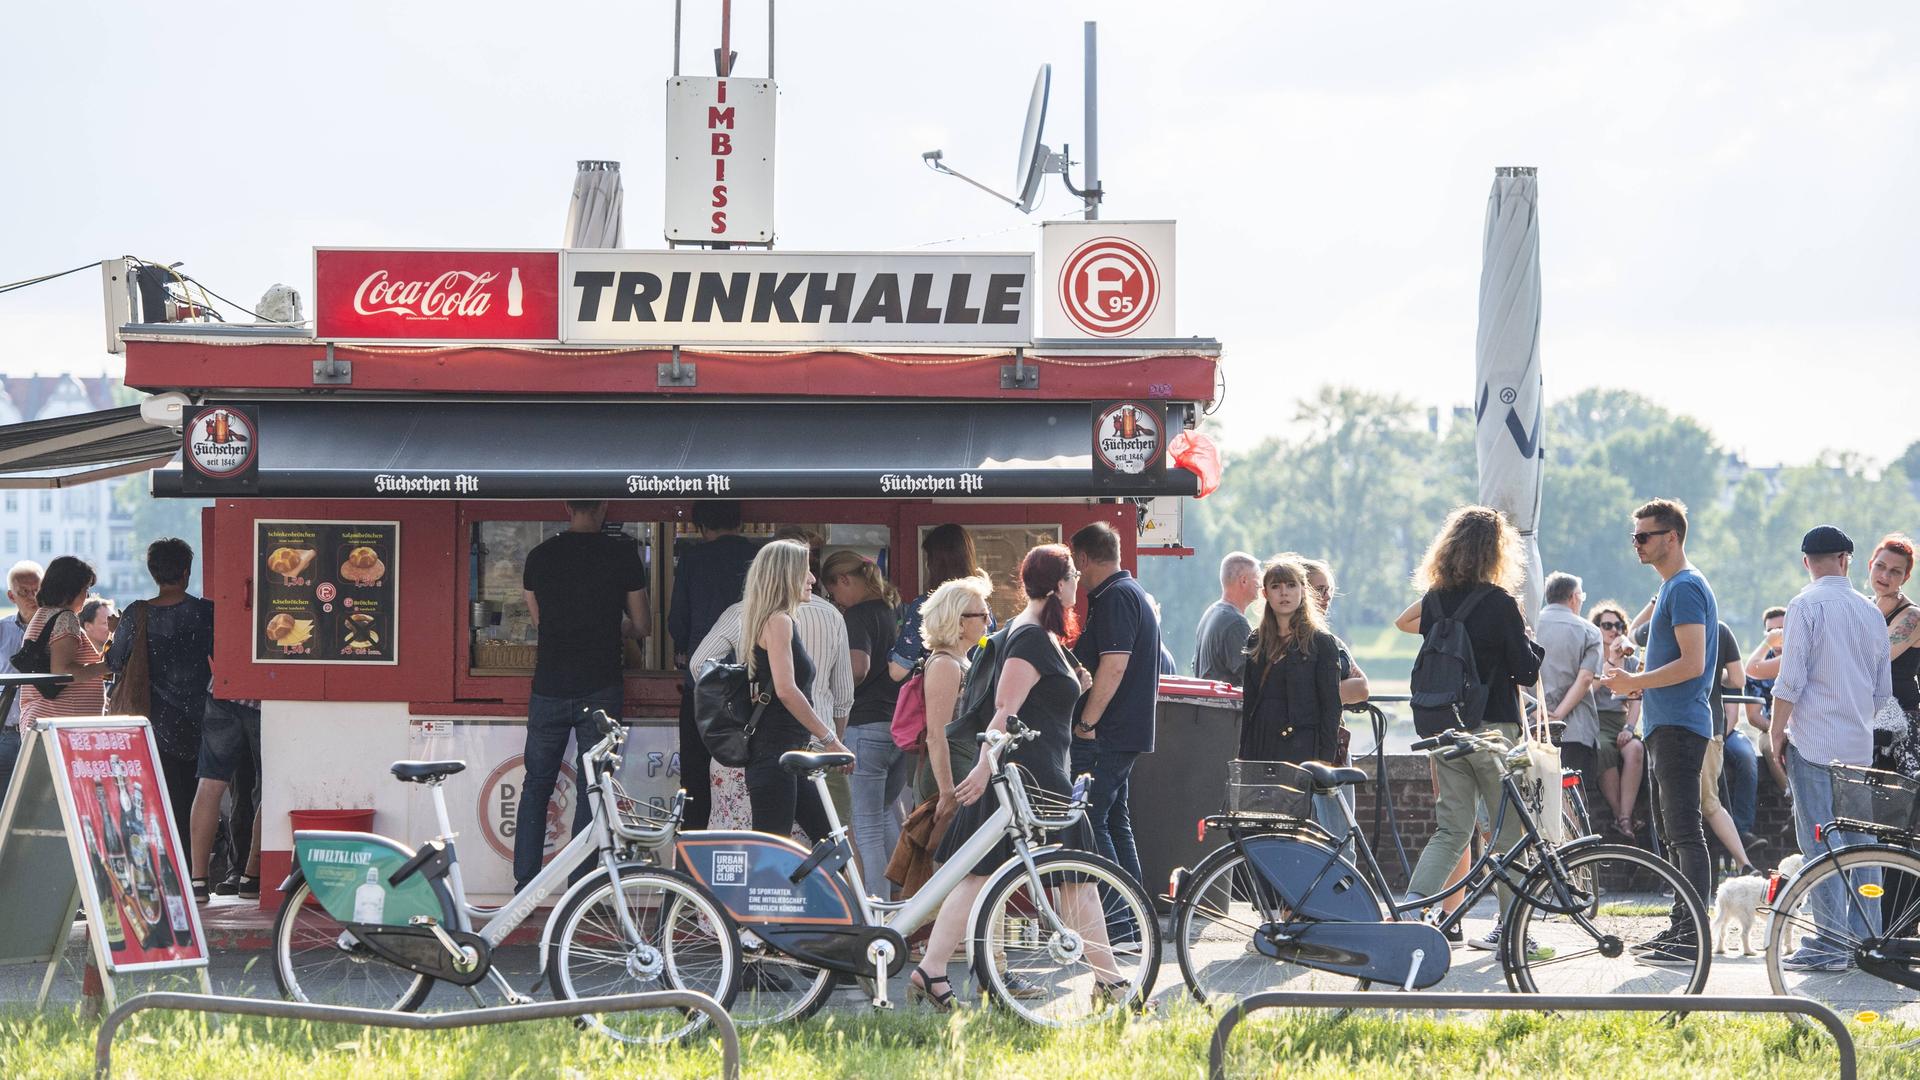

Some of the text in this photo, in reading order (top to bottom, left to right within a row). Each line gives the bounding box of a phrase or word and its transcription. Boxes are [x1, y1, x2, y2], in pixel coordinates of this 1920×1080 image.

[708, 81, 735, 234] IMBISS
[354, 270, 500, 317] Coca-Cola
[573, 271, 1026, 325] TRINKHALLE
[1109, 296, 1134, 313] 95
[194, 442, 248, 457] Füchschen
[1101, 438, 1156, 453] Füchschen
[374, 474, 479, 494] Füchschen Alt
[626, 473, 731, 495] Füchschen Alt
[880, 472, 983, 494] Füchschen Alt
[717, 855, 744, 864] URBAN
[716, 864, 743, 873] SPORTS
[716, 873, 735, 881] CLUB
[757, 888, 792, 896] SPORTARTEN.
